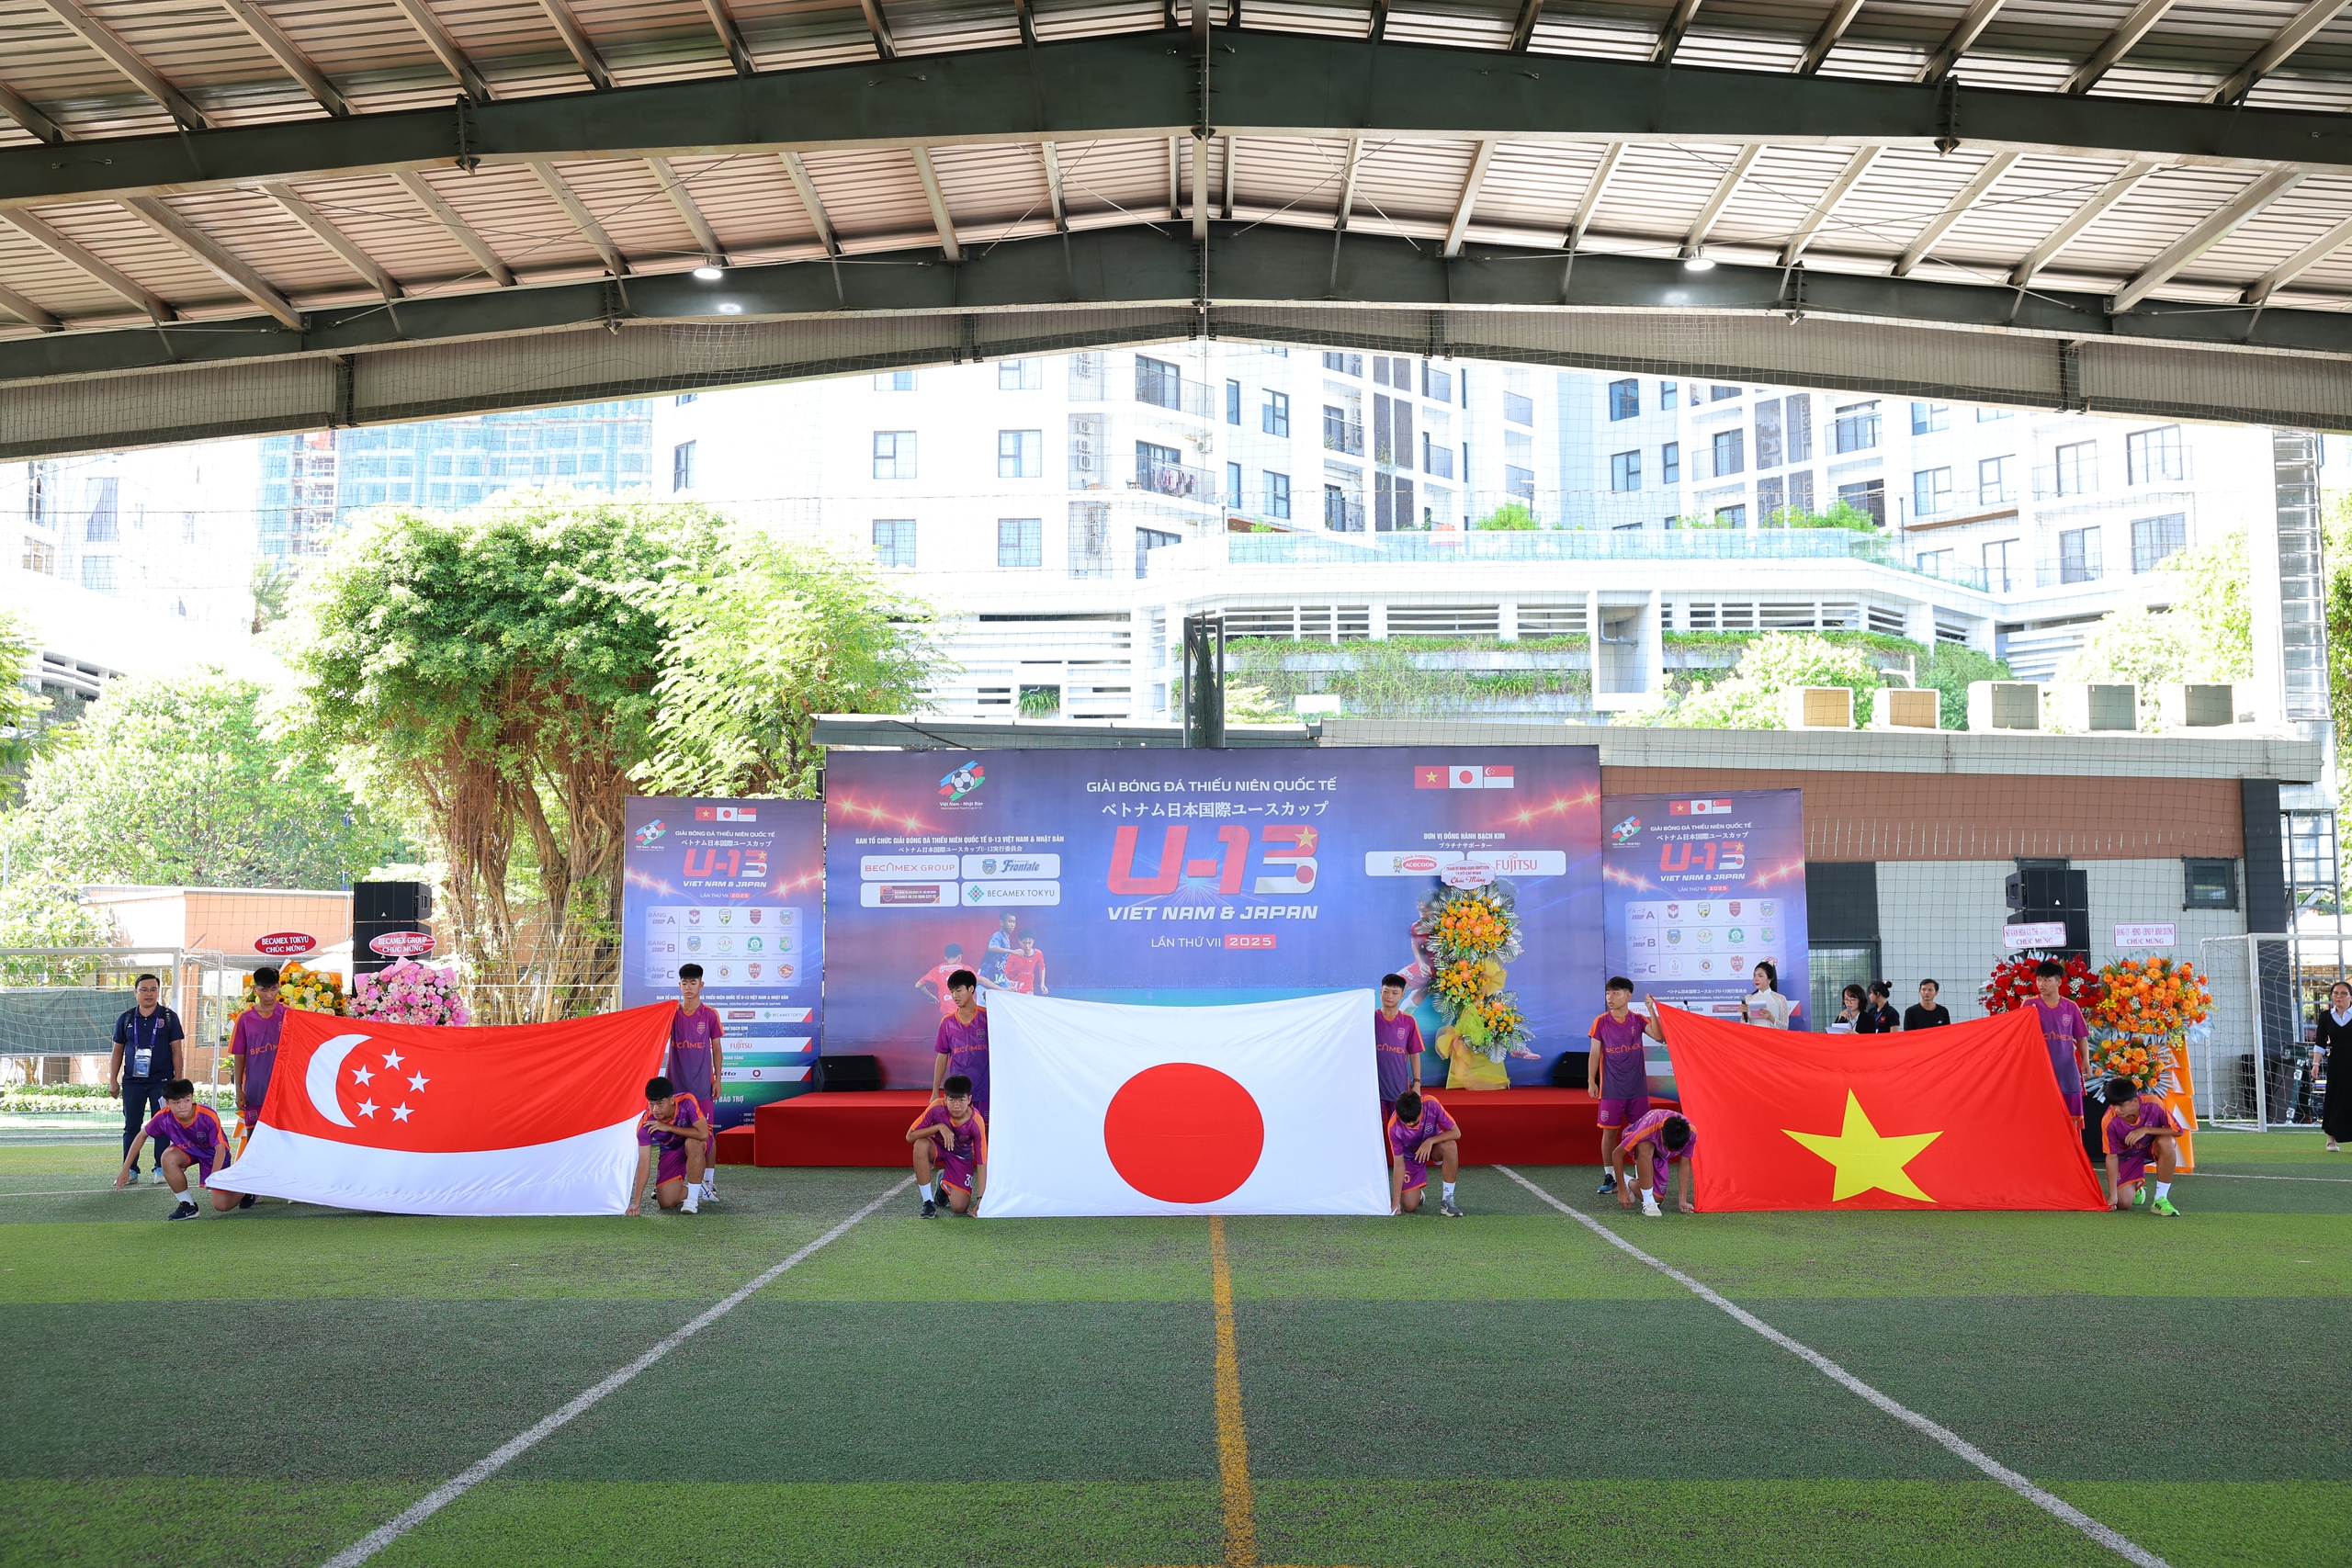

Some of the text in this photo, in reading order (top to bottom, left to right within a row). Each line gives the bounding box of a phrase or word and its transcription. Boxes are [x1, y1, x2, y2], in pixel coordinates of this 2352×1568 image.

[1086, 777, 1337, 792] GIẢI BÓNG ĐÁ THIẾU NIÊN QUỐC TẾ
[1102, 800, 1329, 818] ベトナム日本国際ユースカップ
[868, 836, 876, 844] TỔ
[964, 835, 979, 843] QUỐC
[1002, 835, 1014, 843] VIỆT
[1036, 835, 1051, 843] NHẬT
[1052, 834, 1064, 842] BẢN
[1444, 831, 1459, 840] ĐỒNG
[1657, 832, 1749, 840] ベトナム日本国際ユースカップ
[1106, 825, 1319, 895] U-13
[1659, 841, 1745, 871] U-13
[684, 849, 768, 877] U-13
[1001, 859, 1040, 874] Frontale
[1496, 852, 1537, 874] FUJITSU
[1108, 906, 1318, 920] VIET NAM & JAPAN
[1646, 911, 1655, 919] A
[667, 916, 675, 924] A
[289, 936, 309, 944] TOKYU
[378, 937, 405, 945] BECAMEX
[1151, 935, 1272, 948] LẦN THỨ VII 2025
[1648, 939, 1656, 947] B
[2017, 937, 2034, 945] CHÚC
[266, 943, 306, 953] CHÚC MỪNG
[382, 943, 424, 953] CHÚC MỪNG
[1649, 964, 1657, 973] C
[729, 1040, 752, 1050] FUJITSU
[719, 1094, 744, 1103] BẢO TRỢ
